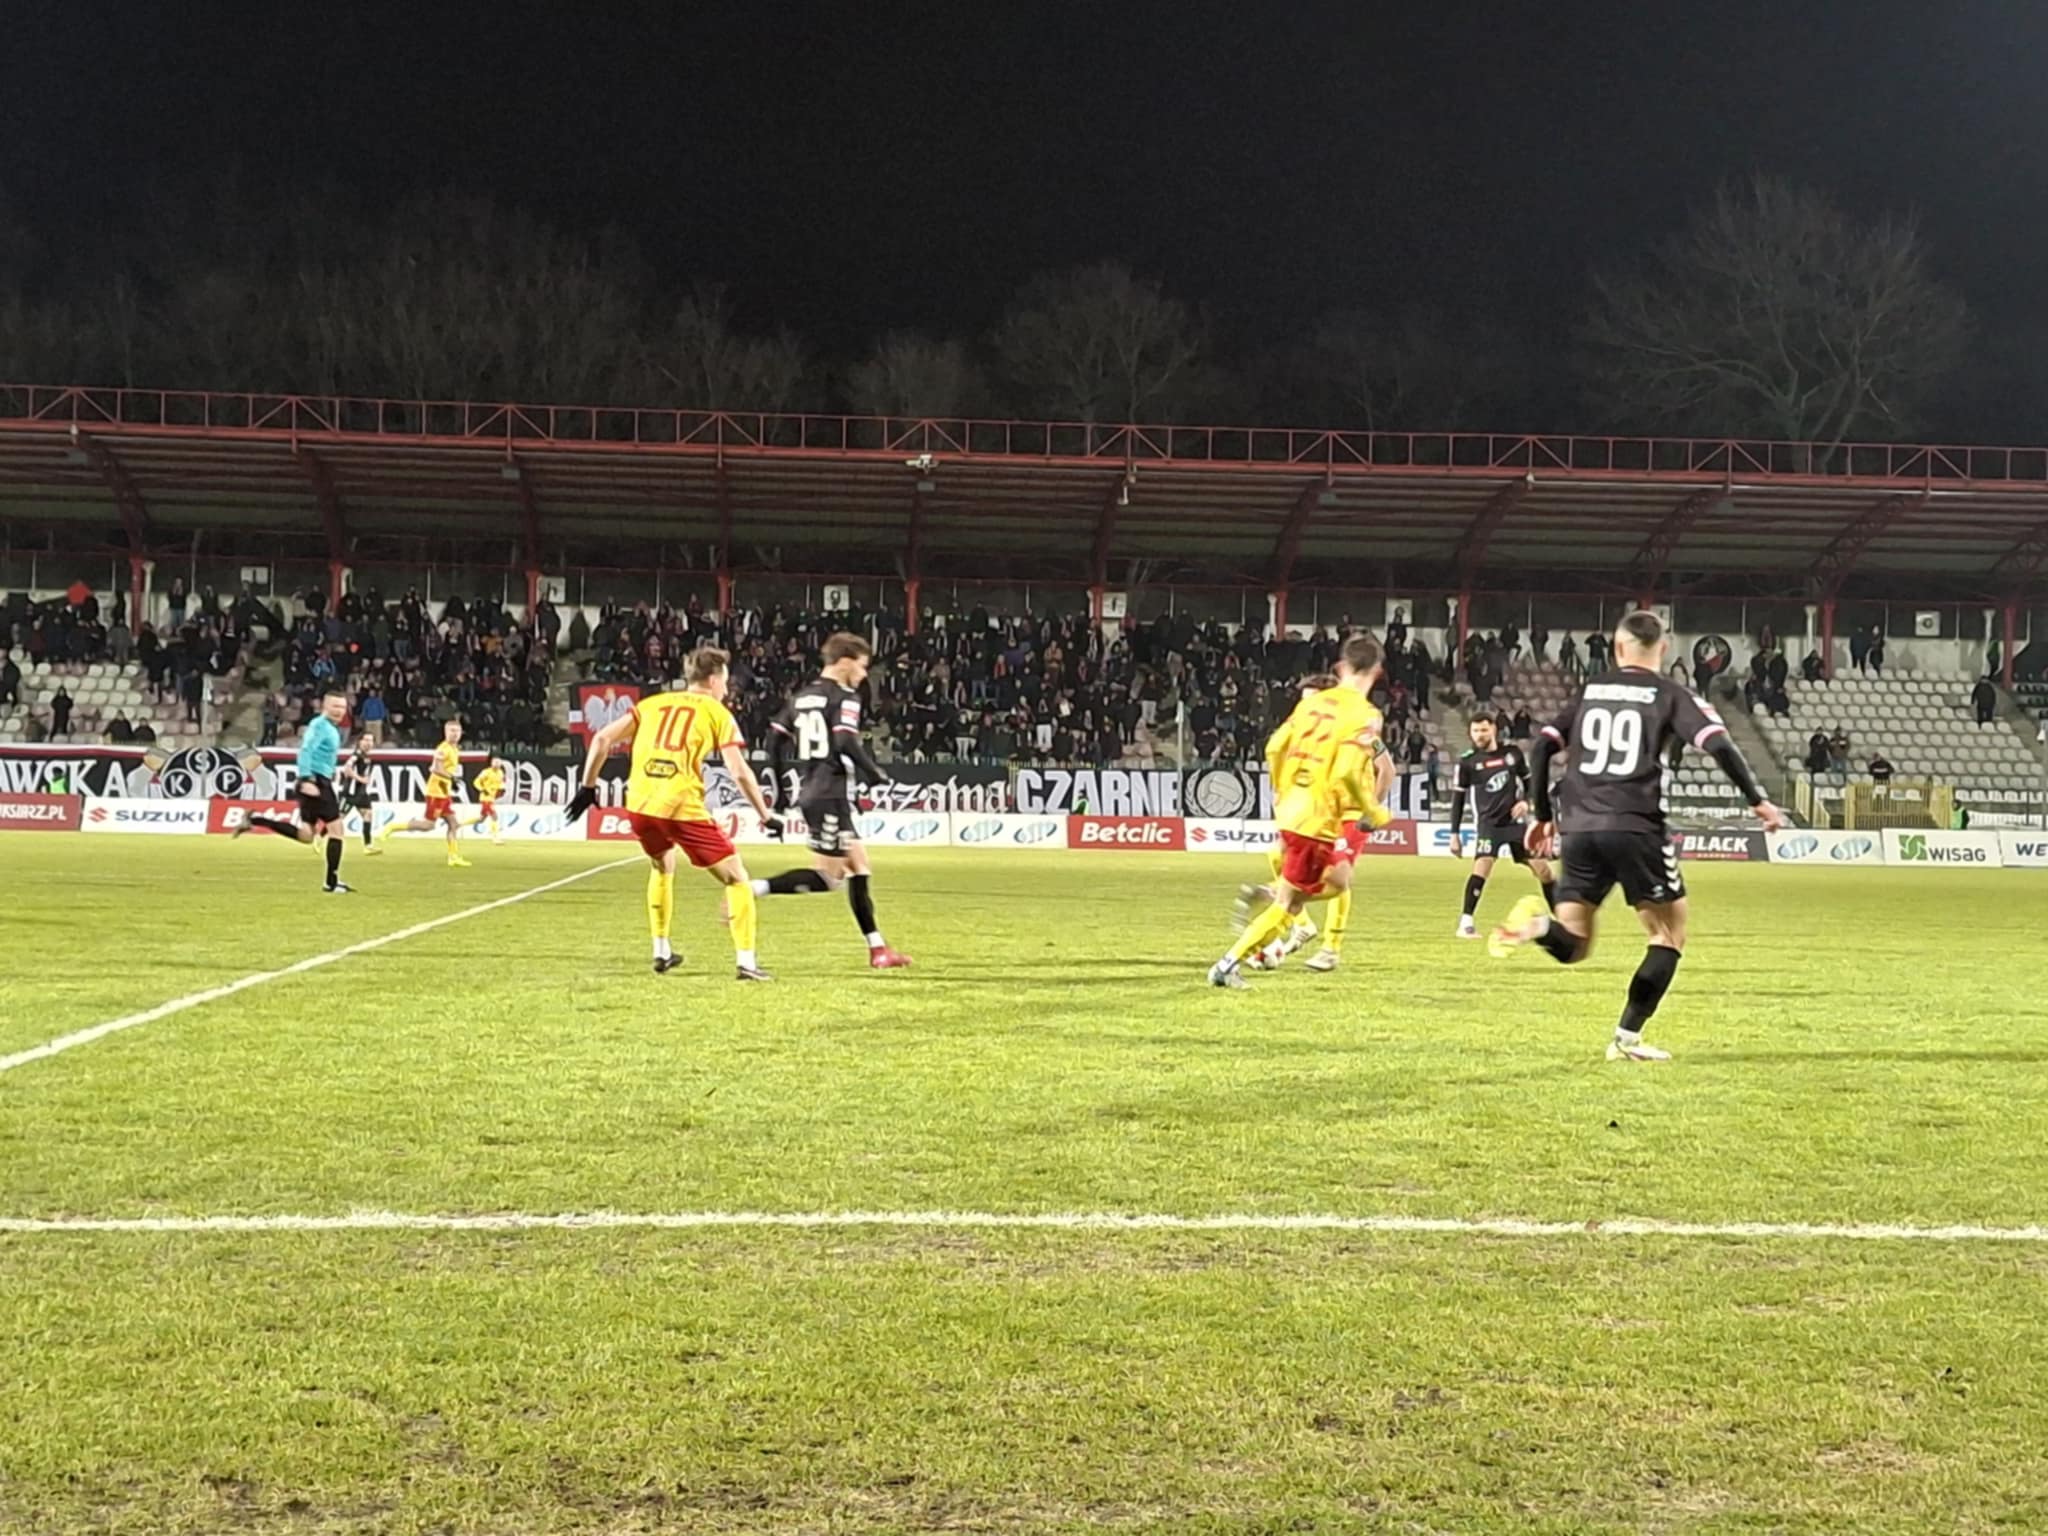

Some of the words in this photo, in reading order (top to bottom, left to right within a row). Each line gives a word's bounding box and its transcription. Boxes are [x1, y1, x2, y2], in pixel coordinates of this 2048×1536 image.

[654, 705, 696, 752] 10
[794, 710, 829, 760] 19
[1579, 707, 1642, 775] 99
[115, 809, 204, 822] SUZUKI
[1016, 769, 1183, 817] CZARNE
[1080, 821, 1174, 844] Betclic
[1682, 835, 1750, 853] BLACK
